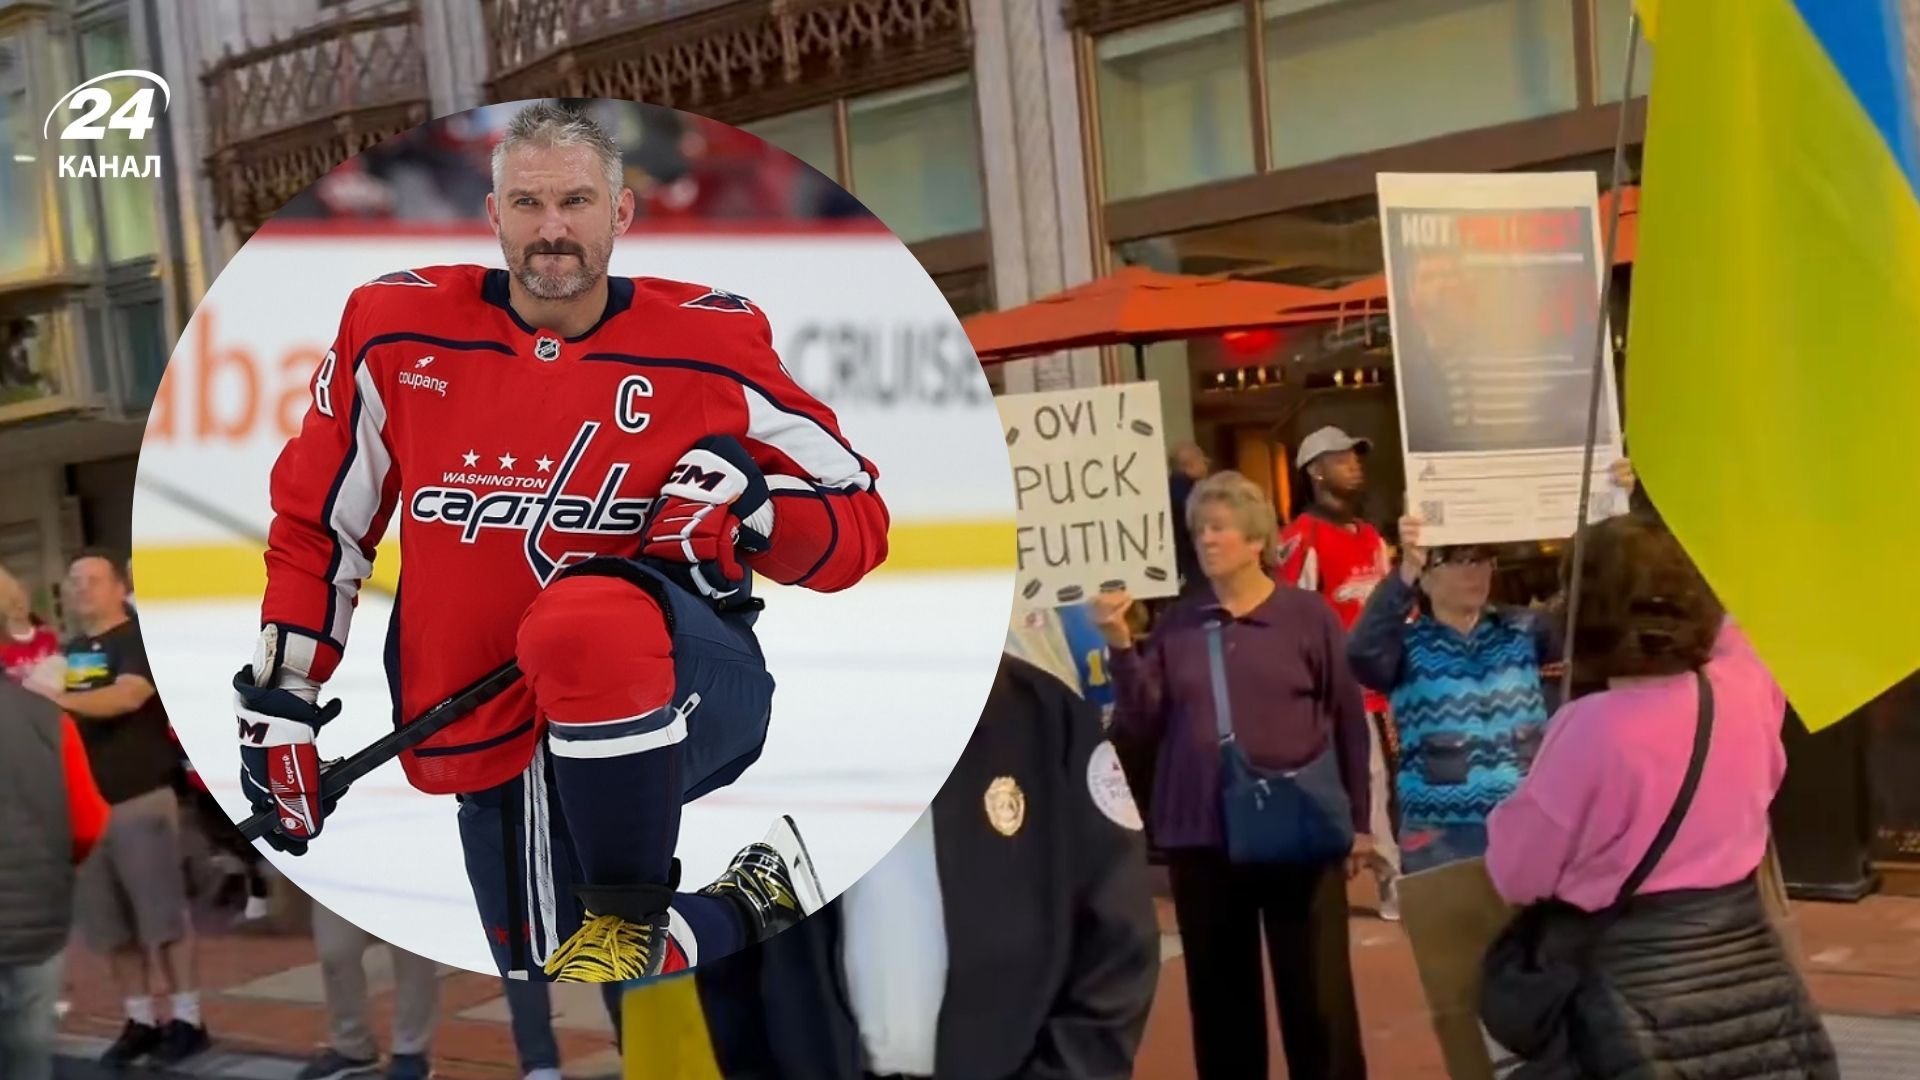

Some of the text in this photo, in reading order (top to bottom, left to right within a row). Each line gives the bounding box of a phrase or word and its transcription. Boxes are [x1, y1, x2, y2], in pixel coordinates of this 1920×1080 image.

[398, 371, 448, 397] coupang
[614, 374, 654, 434] C
[442, 471, 548, 489] WASHINGTON
[1013, 451, 1141, 511] PUCK
[1016, 511, 1165, 571] FUTIN!
